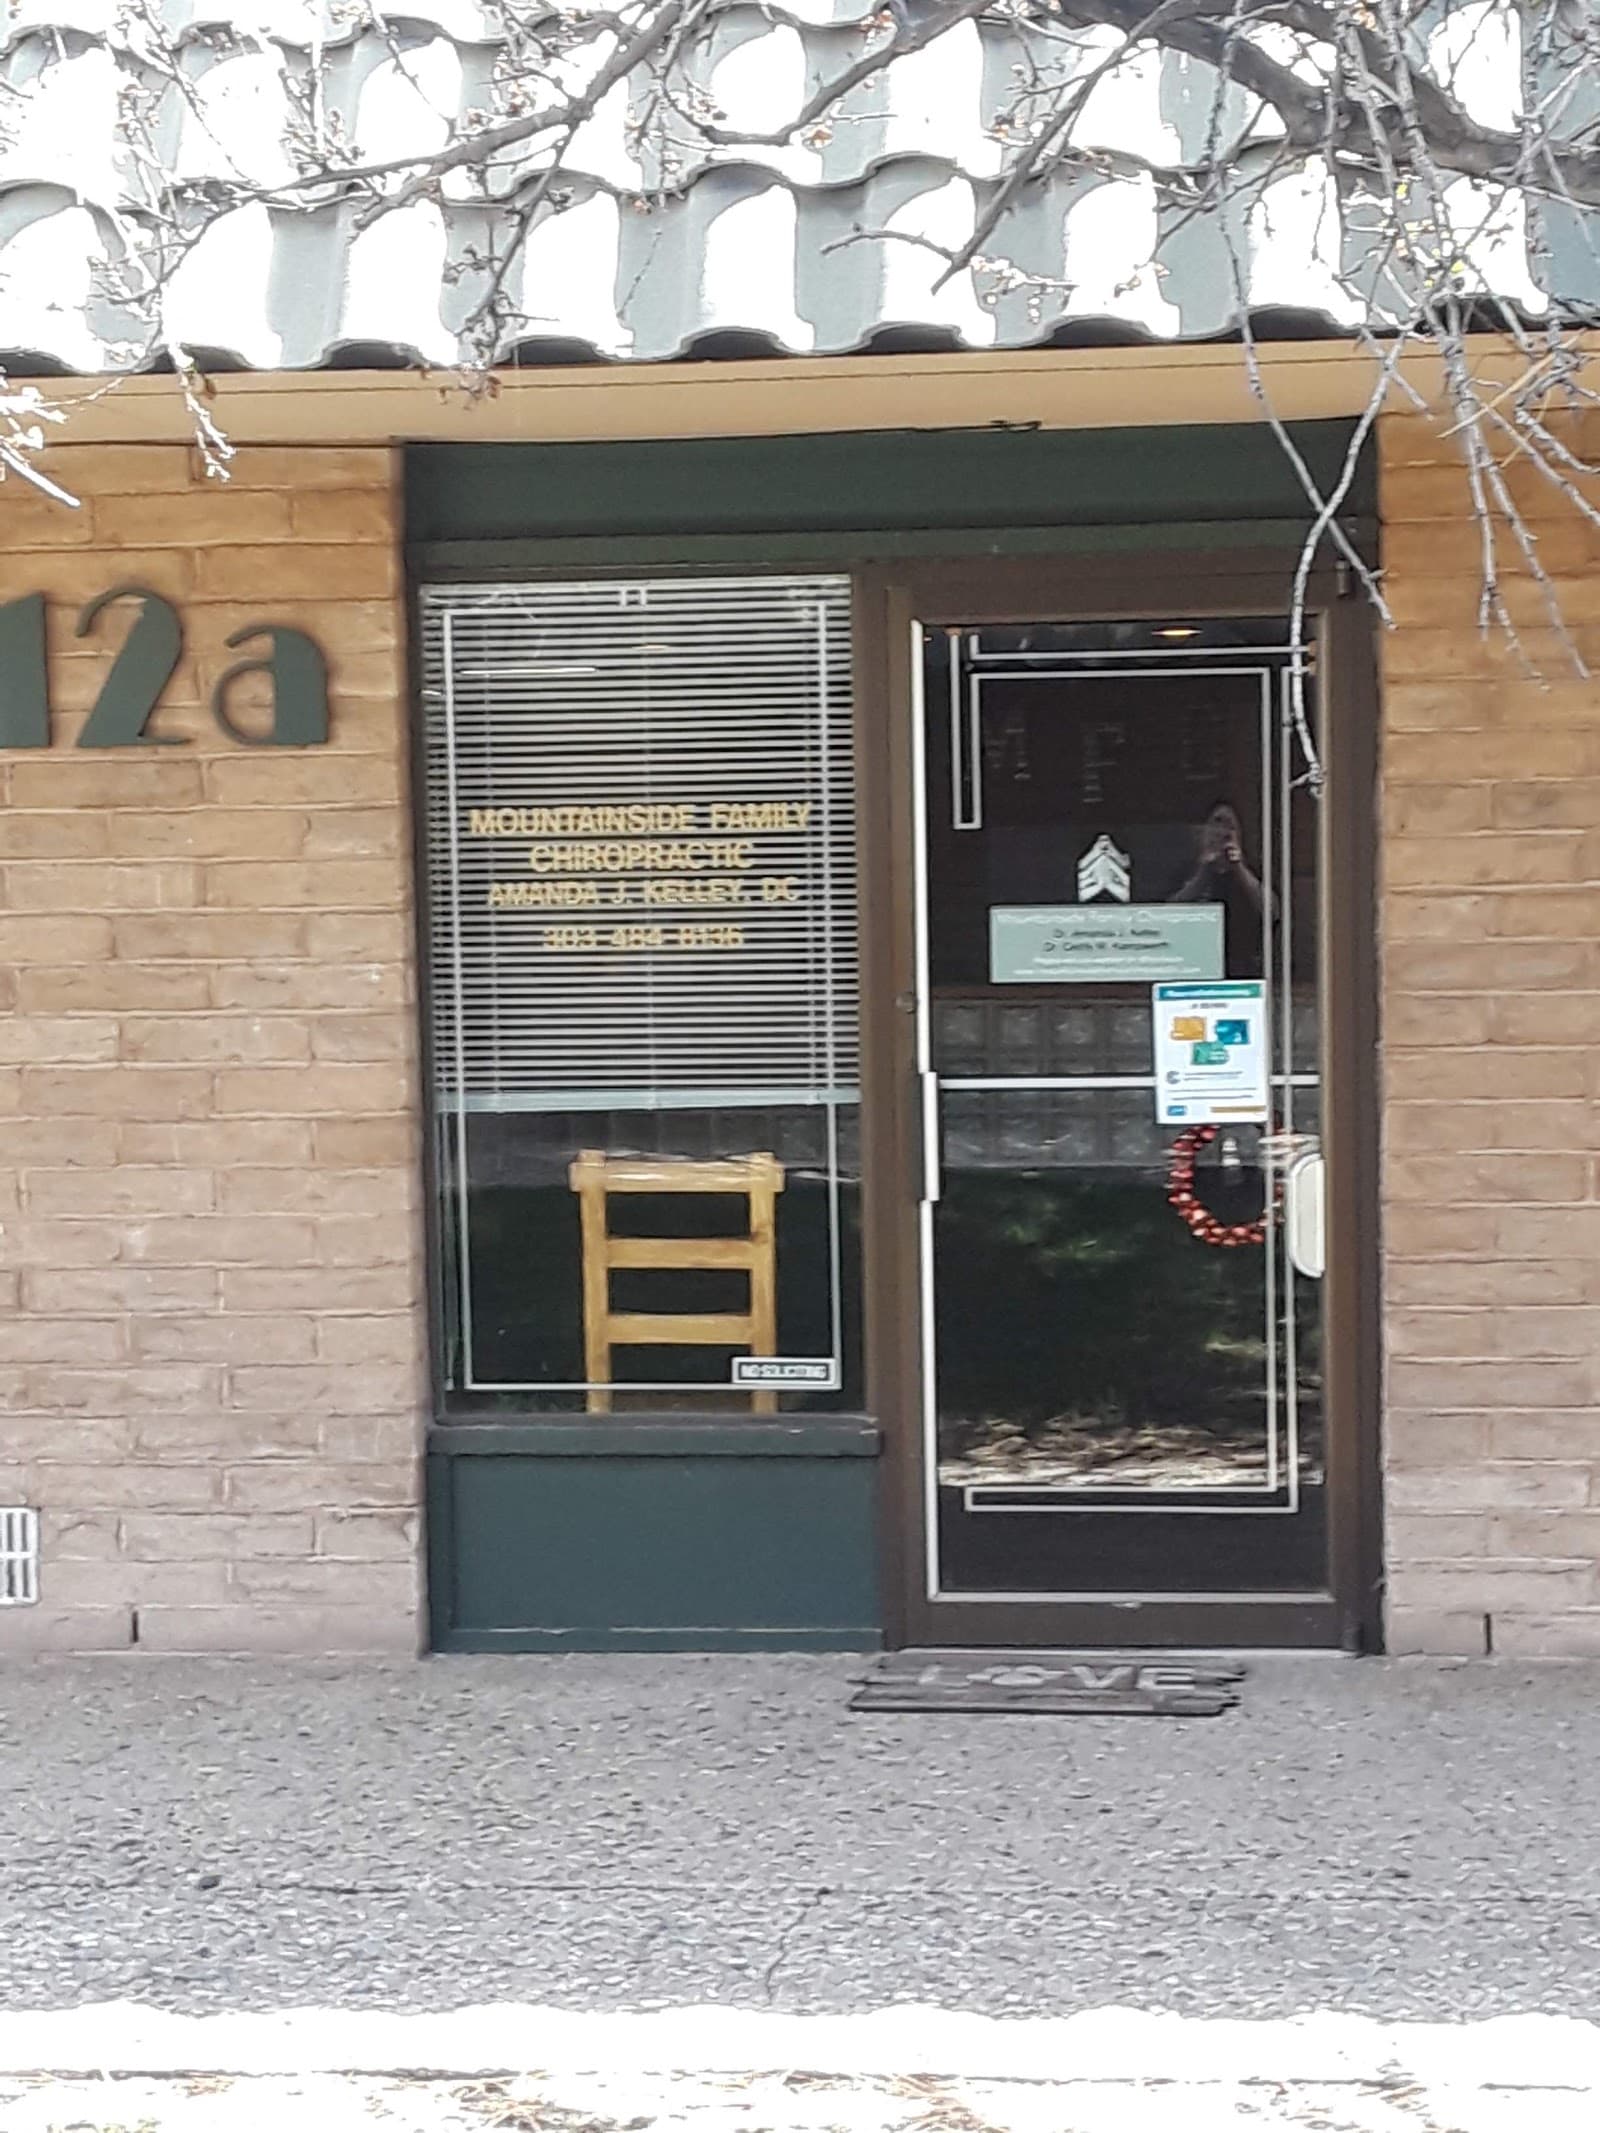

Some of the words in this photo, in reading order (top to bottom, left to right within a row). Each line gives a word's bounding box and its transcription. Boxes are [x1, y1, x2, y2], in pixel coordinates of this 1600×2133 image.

[0, 587, 331, 748] 12a
[470, 805, 696, 834] MOUNTAINSIDE
[710, 802, 812, 829] FAMILY
[531, 840, 754, 872] CHIROPRACTIC
[489, 881, 598, 907] AMANDA
[762, 876, 800, 901] DC
